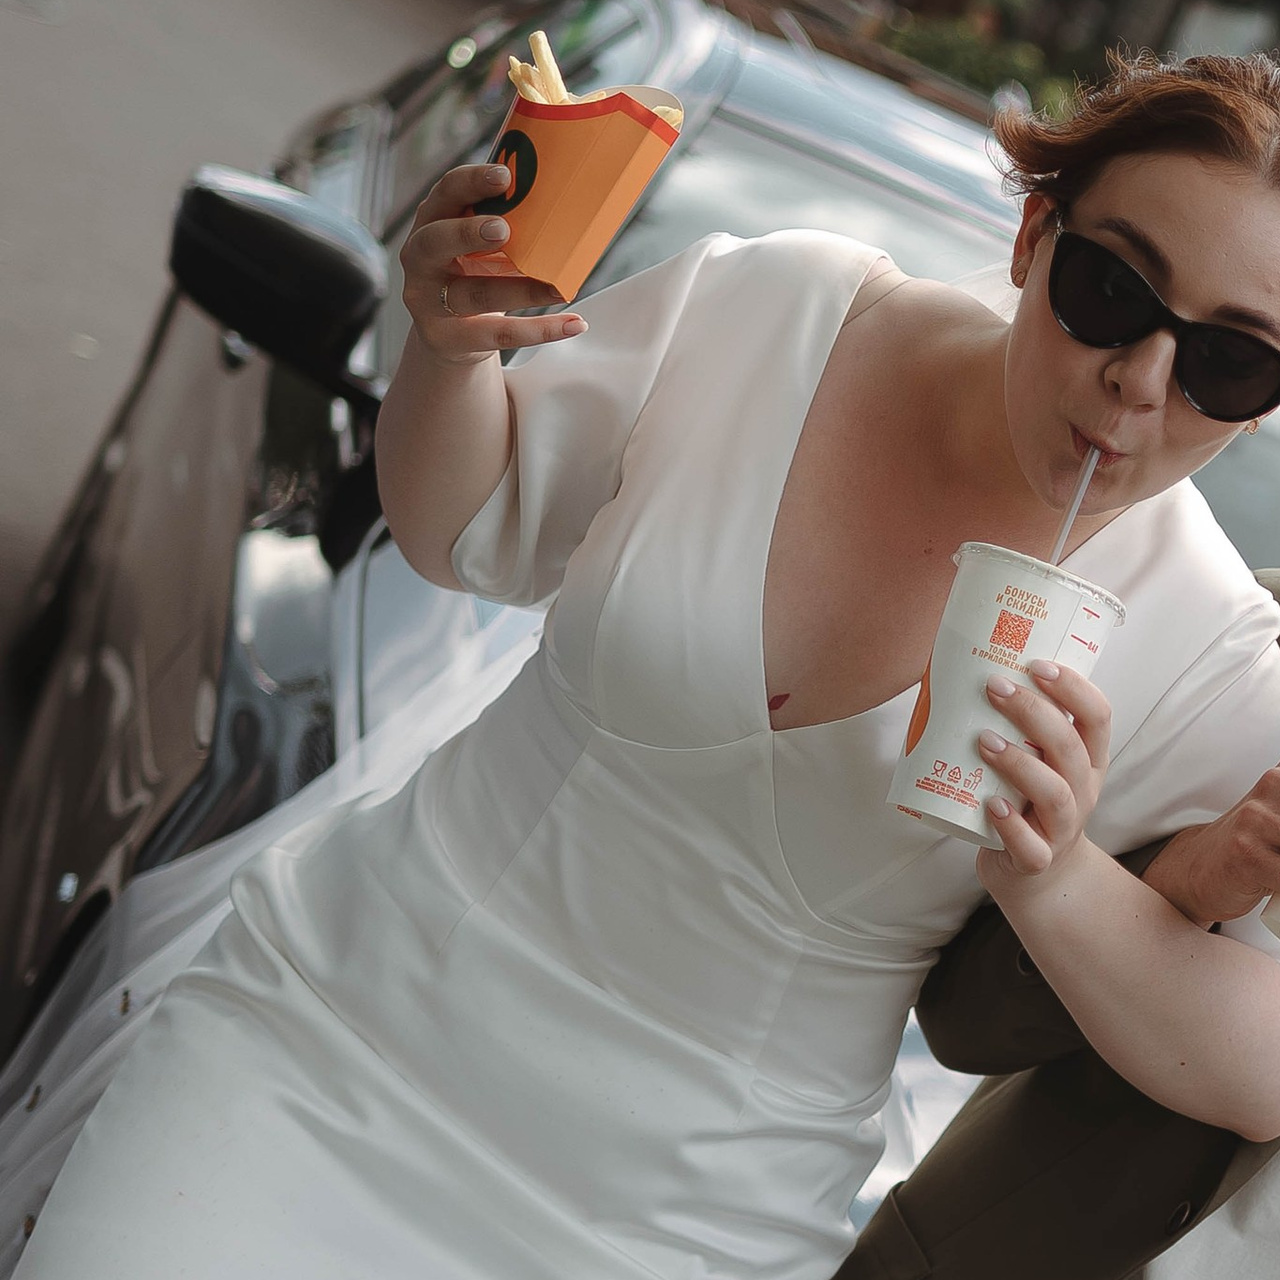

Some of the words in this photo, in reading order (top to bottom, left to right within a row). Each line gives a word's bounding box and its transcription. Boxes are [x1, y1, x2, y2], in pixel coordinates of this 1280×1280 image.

[995, 592, 1005, 604] И
[1006, 597, 1049, 621] СКИДКИ
[1004, 585, 1048, 609] БОНУСЫ
[971, 646, 978, 656] В
[978, 649, 1031, 676] ПРИЛОЖЕНИИ
[988, 644, 1018, 661] ТОЛЬКО
